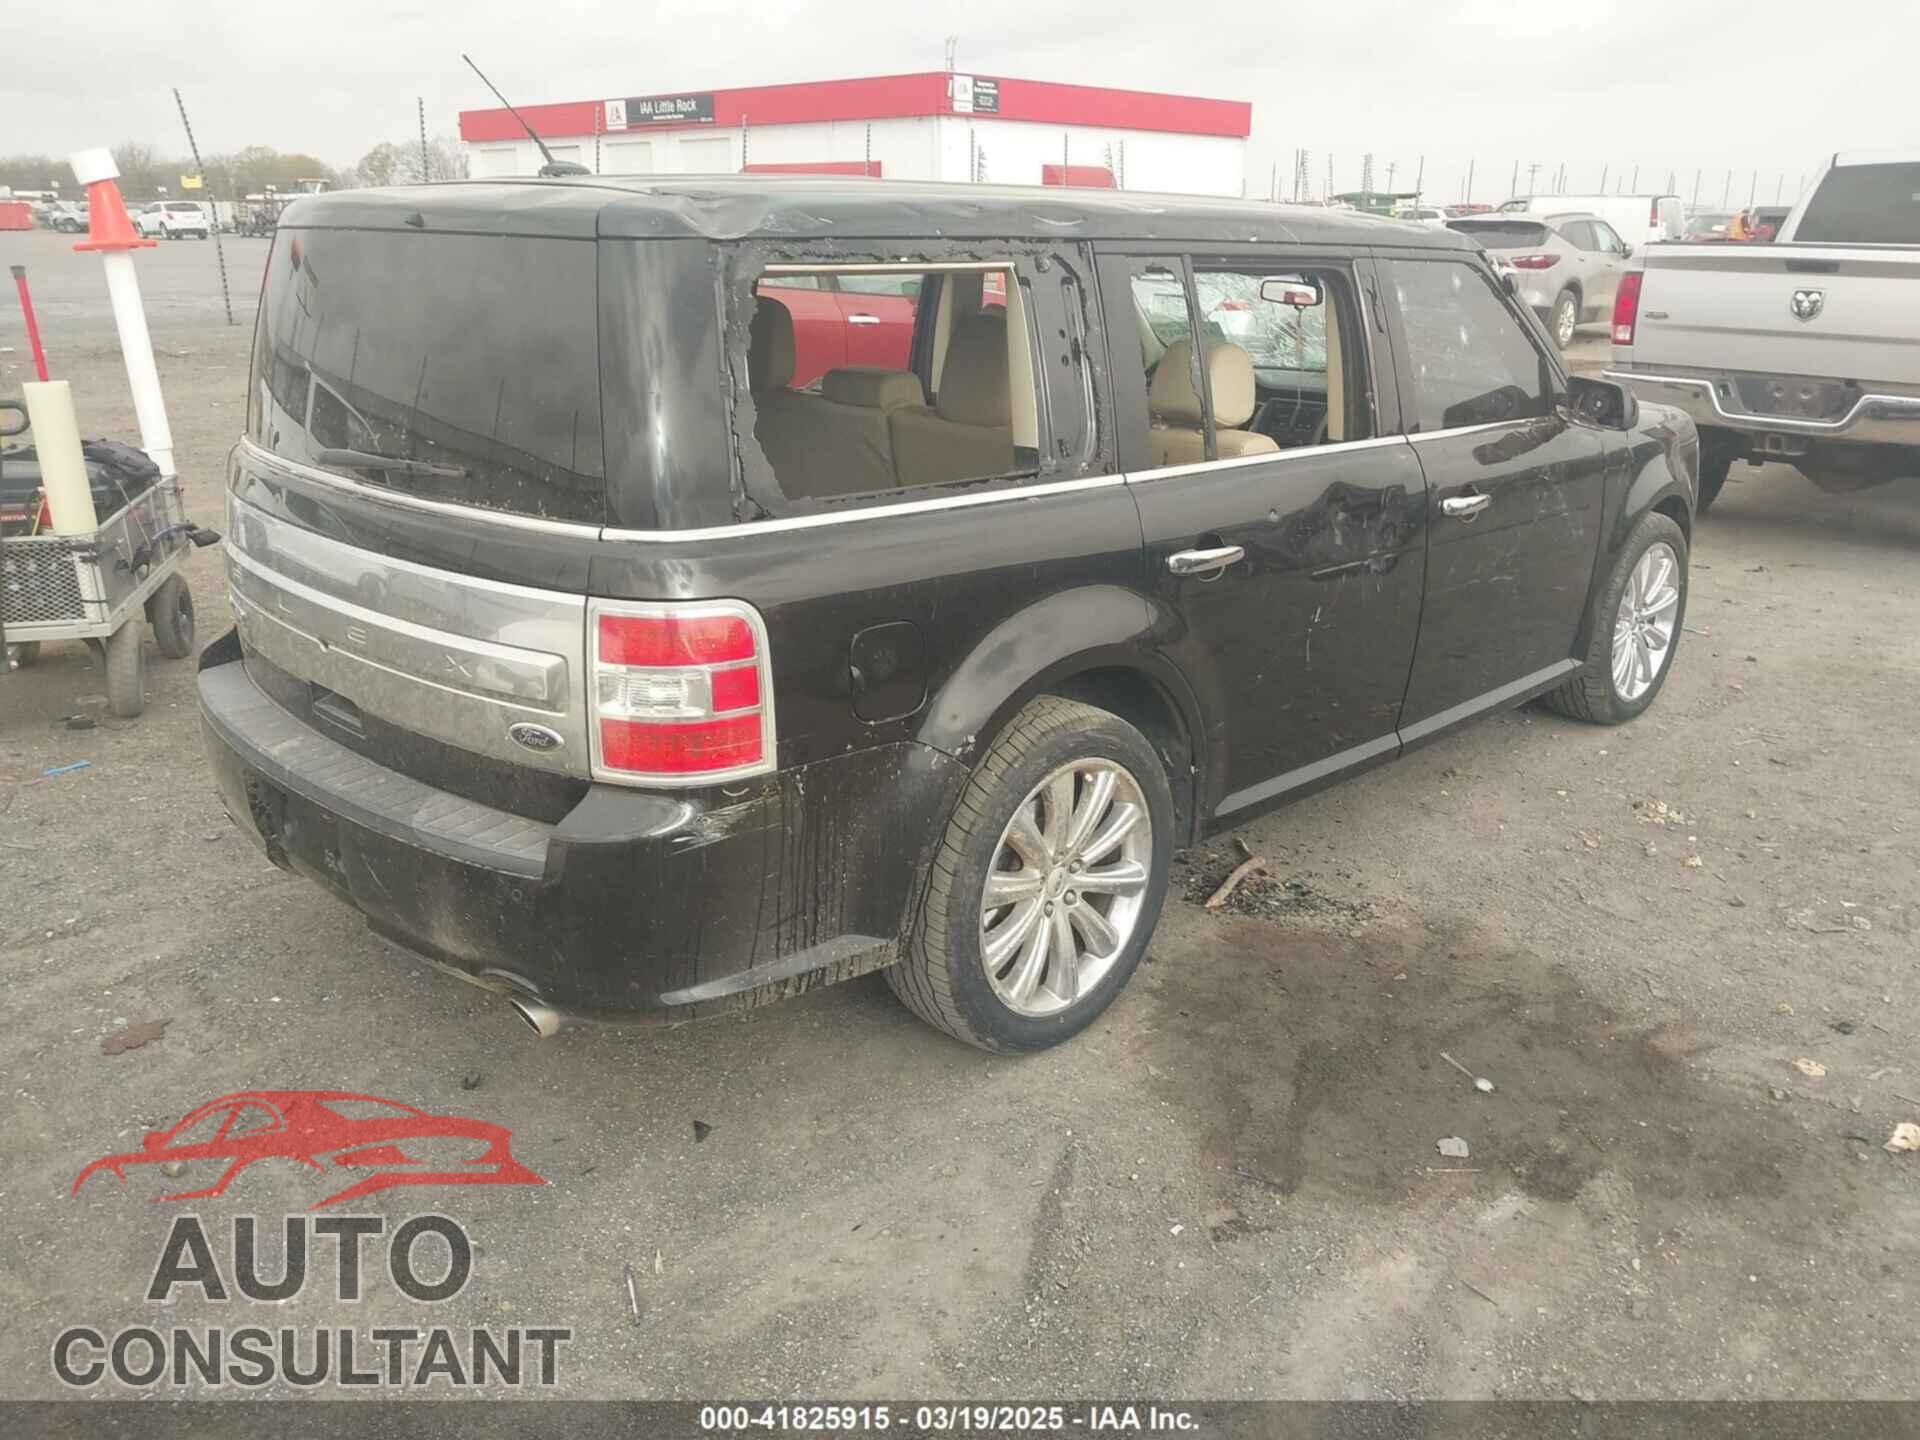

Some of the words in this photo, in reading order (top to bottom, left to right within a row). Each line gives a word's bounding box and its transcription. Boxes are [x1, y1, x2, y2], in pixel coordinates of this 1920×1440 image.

[655, 100, 675, 113] Little
[677, 98, 697, 112] Rock
[518, 729, 550, 746] Ford
